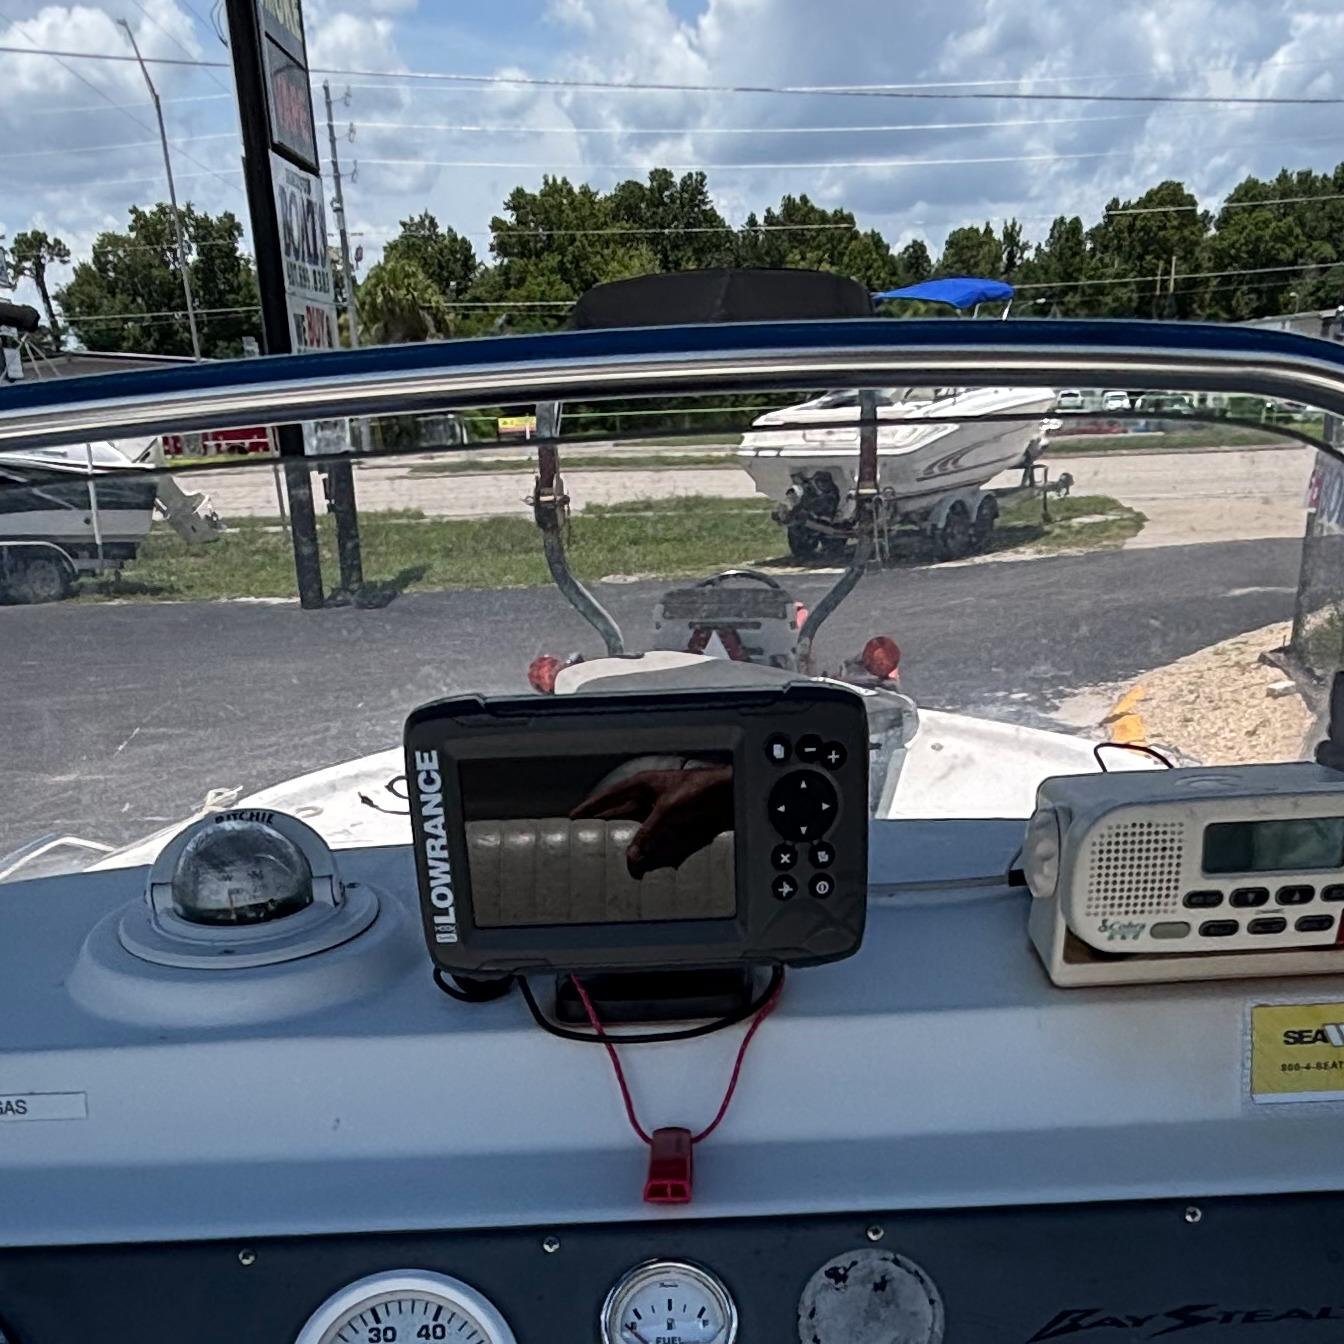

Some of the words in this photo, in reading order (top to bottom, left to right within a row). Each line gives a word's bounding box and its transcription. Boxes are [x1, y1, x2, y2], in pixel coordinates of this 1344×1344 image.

[415, 750, 457, 926] LOWRANCE
[1283, 1029, 1329, 1046] SEA
[368, 1326, 397, 1344] 30
[416, 1324, 446, 1341] 40
